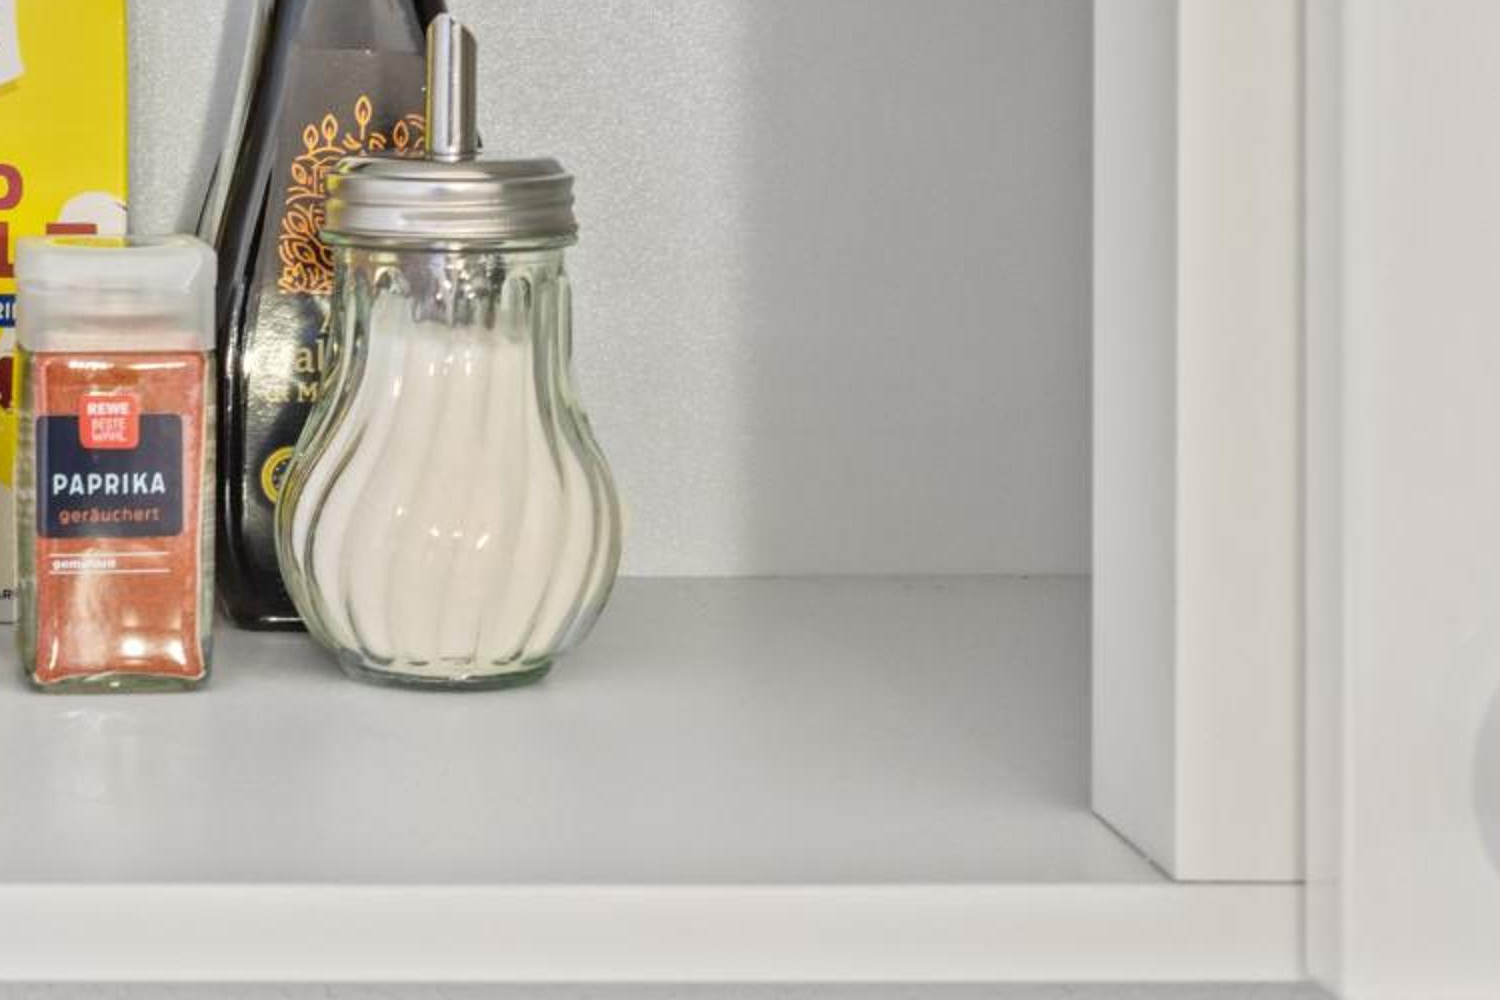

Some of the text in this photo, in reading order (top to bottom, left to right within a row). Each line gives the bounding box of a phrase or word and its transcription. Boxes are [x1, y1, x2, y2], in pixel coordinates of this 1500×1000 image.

[86, 401, 131, 416] REWE
[52, 471, 167, 496] PAPRIKA
[58, 506, 161, 526] geräuchert
